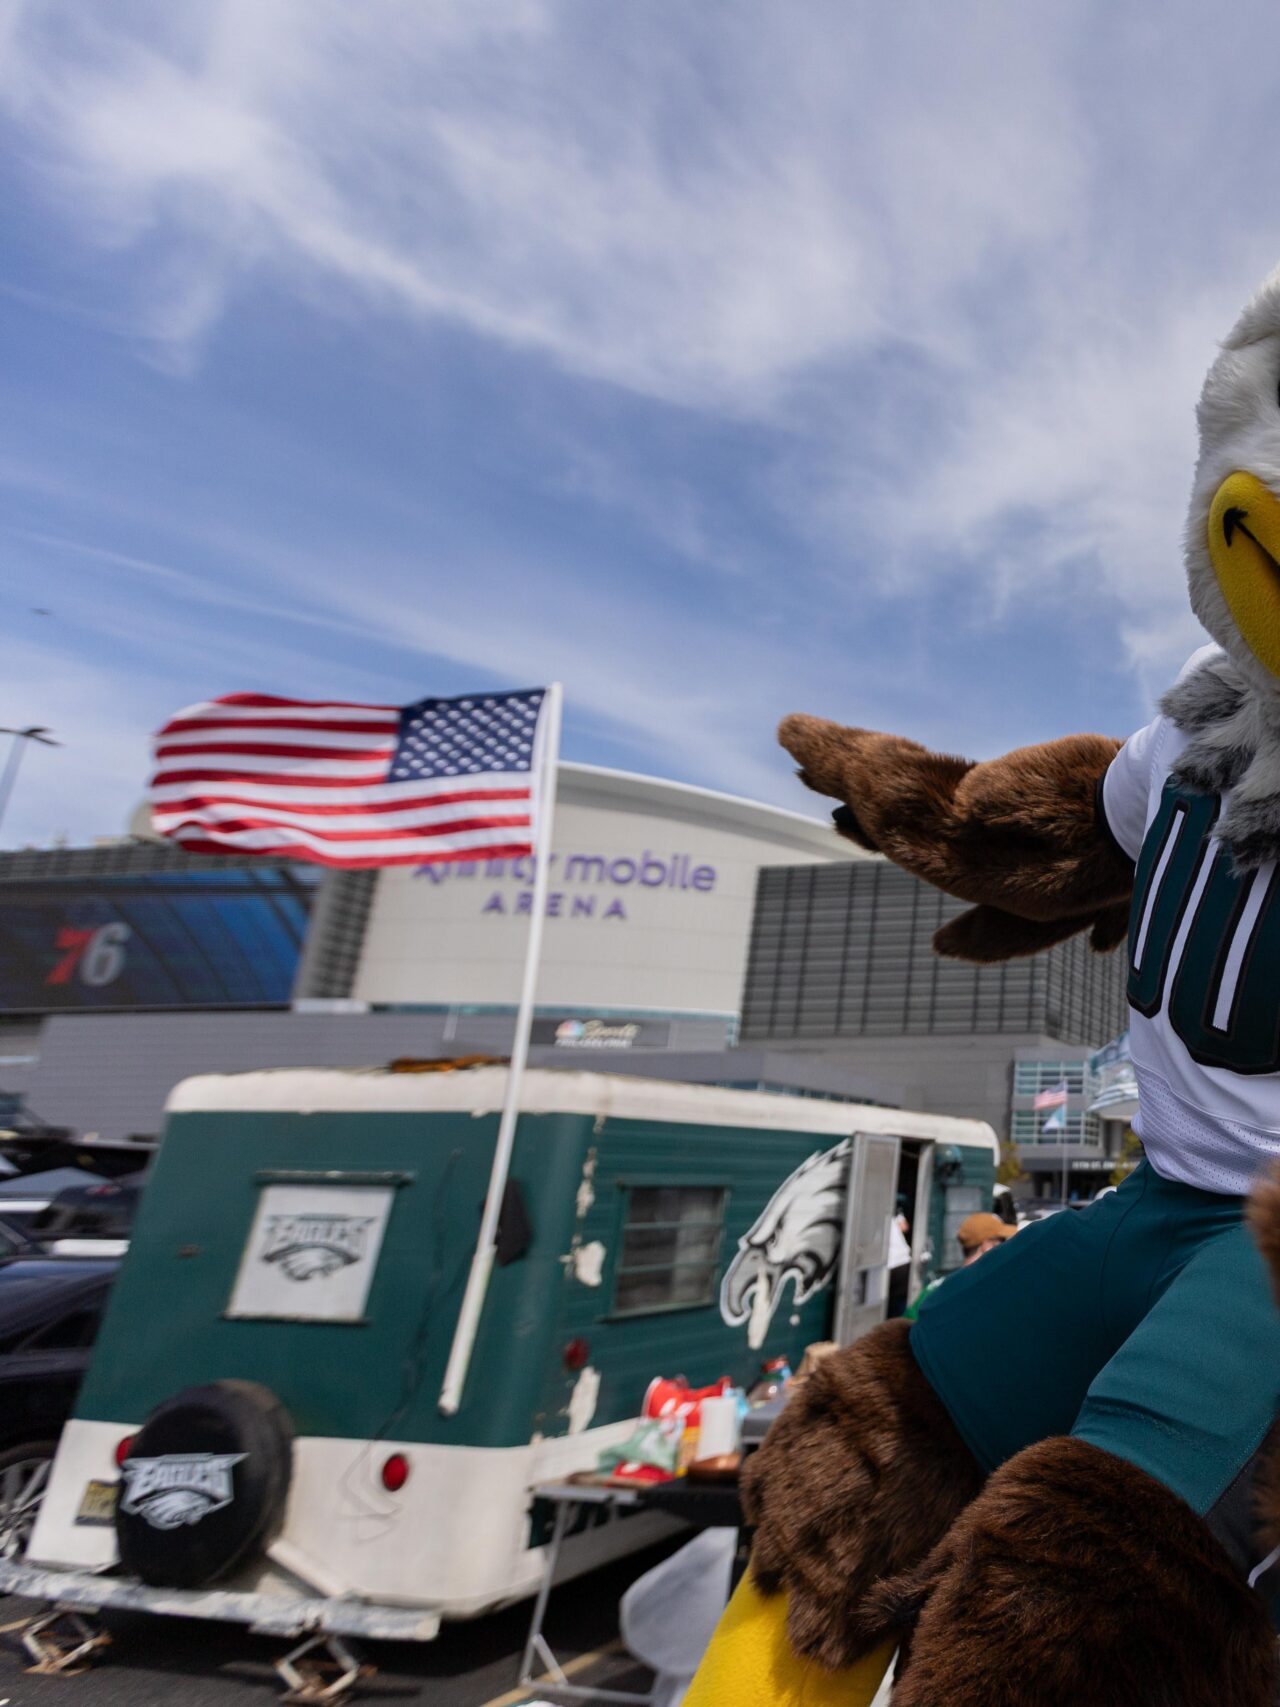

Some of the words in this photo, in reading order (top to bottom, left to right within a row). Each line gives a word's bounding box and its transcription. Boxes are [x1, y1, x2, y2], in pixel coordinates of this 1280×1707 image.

[563, 850, 718, 893] mobile
[482, 892, 628, 920] ARENA
[46, 921, 132, 986] 76
[123, 1453, 248, 1502] EAGLES
